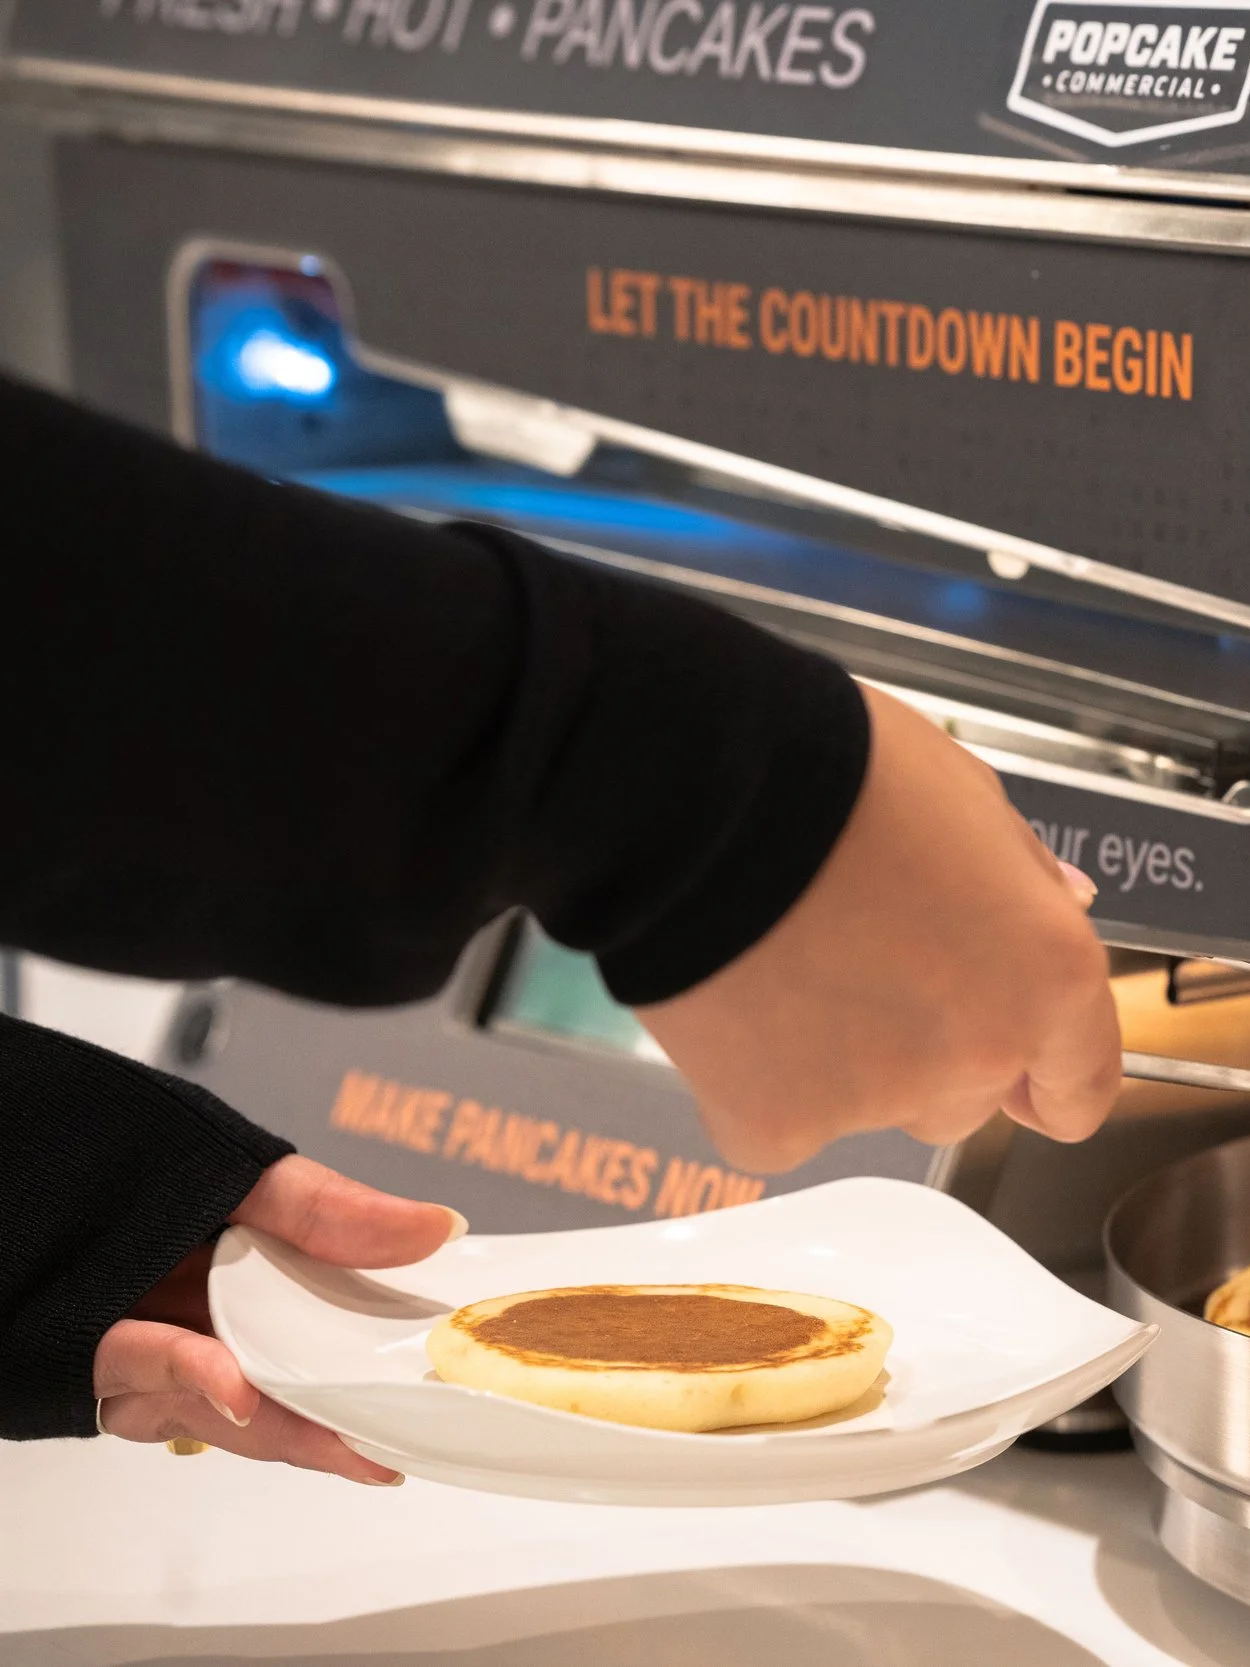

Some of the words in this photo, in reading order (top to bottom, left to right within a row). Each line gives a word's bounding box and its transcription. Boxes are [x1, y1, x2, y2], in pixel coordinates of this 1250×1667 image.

[519, 0, 876, 89] PANCAKES
[1042, 19, 1246, 71] POPCAKE
[1055, 69, 1206, 99] COMMERCIAL
[586, 266, 660, 339] LET
[668, 274, 752, 351] THE
[758, 287, 1041, 383] COUNTDOWN
[1054, 320, 1194, 401] BEGIN
[1098, 832, 1204, 893] eyes.
[331, 1069, 453, 1154] MAKE
[443, 1100, 659, 1212] PANCAKES
